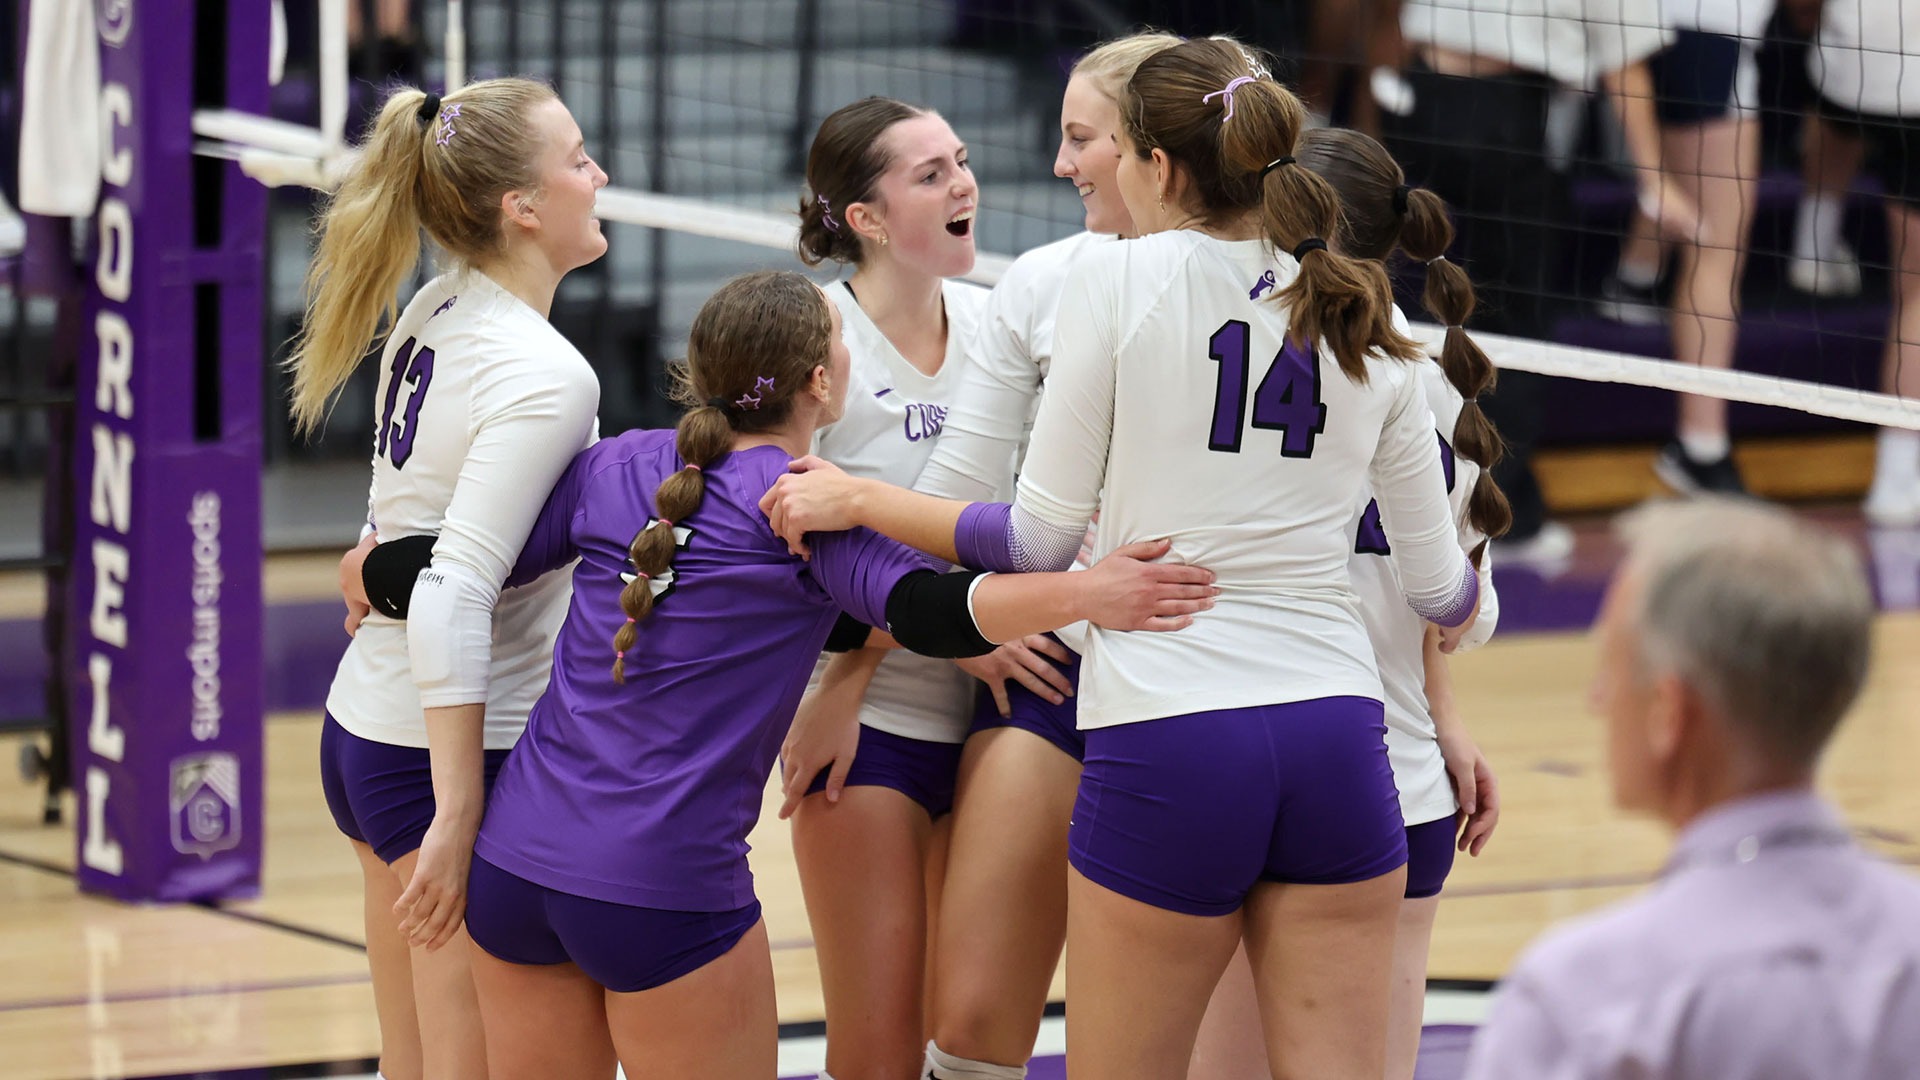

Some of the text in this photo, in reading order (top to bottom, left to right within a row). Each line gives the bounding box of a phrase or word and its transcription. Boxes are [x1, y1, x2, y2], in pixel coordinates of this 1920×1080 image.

[83, 82, 135, 876] CORNELL
[377, 335, 435, 471] 13
[1208, 319, 1327, 459] 14
[187, 490, 224, 741] sports imports
